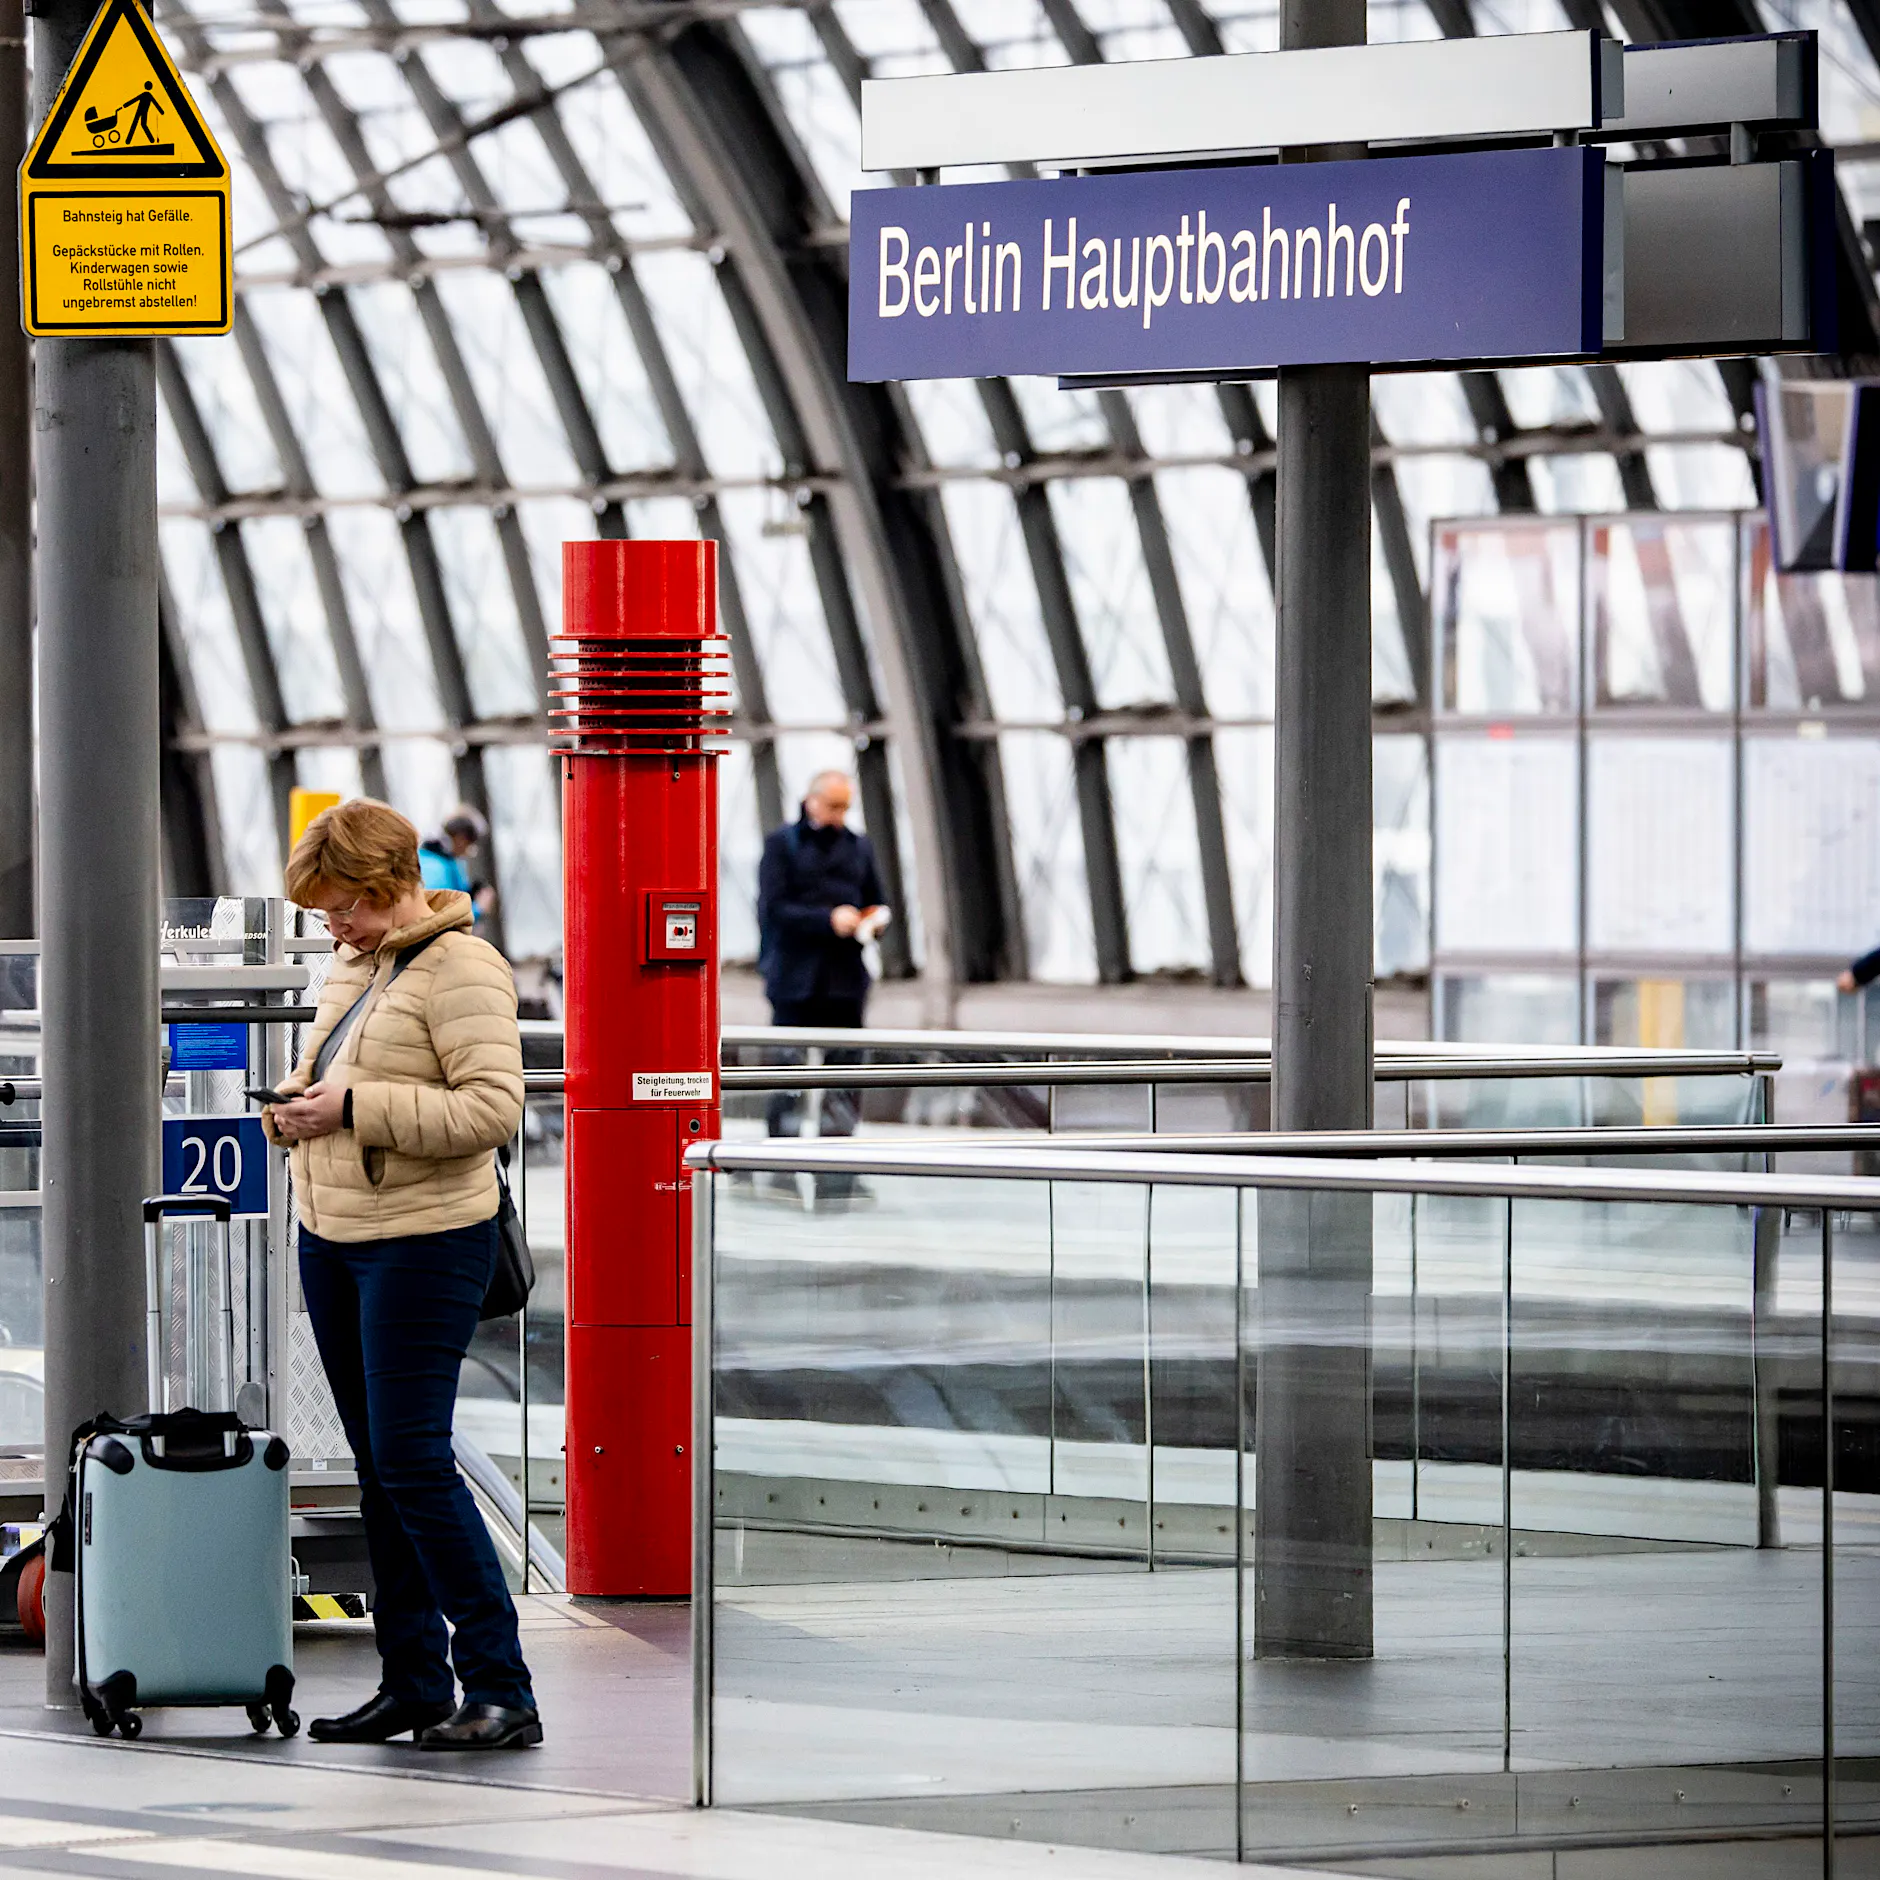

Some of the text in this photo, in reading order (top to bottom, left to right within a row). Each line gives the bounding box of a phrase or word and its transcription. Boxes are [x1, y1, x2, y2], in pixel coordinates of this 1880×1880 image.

[63, 209, 193, 225] Bahnsteig hat Gefälle.
[52, 244, 137, 259] Gepäckstücke
[140, 244, 160, 256] mit
[70, 261, 188, 277] Kinderwagen sowie
[878, 197, 1411, 330] Berlin Hauptbahnhof
[83, 278, 176, 291] Rollstühle nicht
[62, 295, 197, 312] ungebremst abstellen!
[637, 1076, 709, 1087] Steigleitung, trocken
[650, 1087, 701, 1097] für Feuerwehr
[180, 1135, 243, 1193] 20
